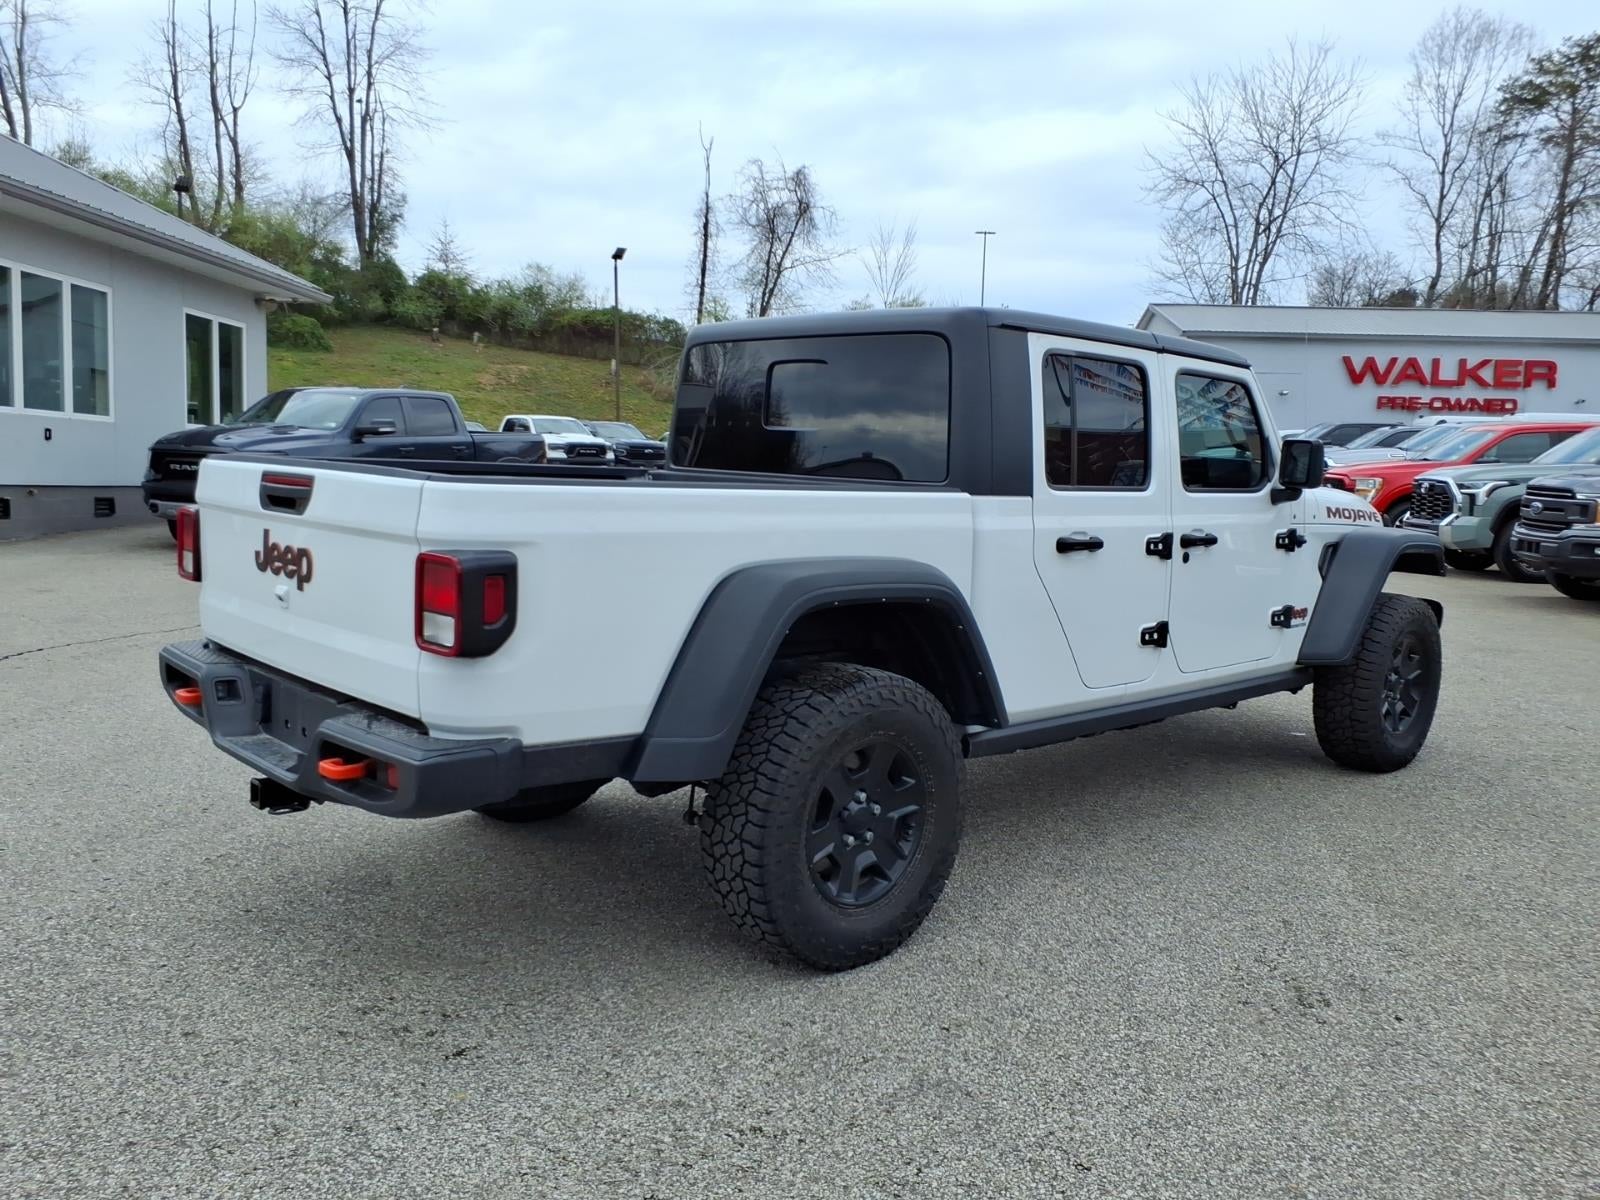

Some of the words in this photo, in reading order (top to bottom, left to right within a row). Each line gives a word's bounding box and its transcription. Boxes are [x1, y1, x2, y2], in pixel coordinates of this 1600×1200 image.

[1342, 355, 1558, 389] WALKER
[1376, 395, 1519, 414] PRE-OWNED
[1326, 506, 1380, 522] MOJAVE
[254, 528, 313, 592] Jeep
